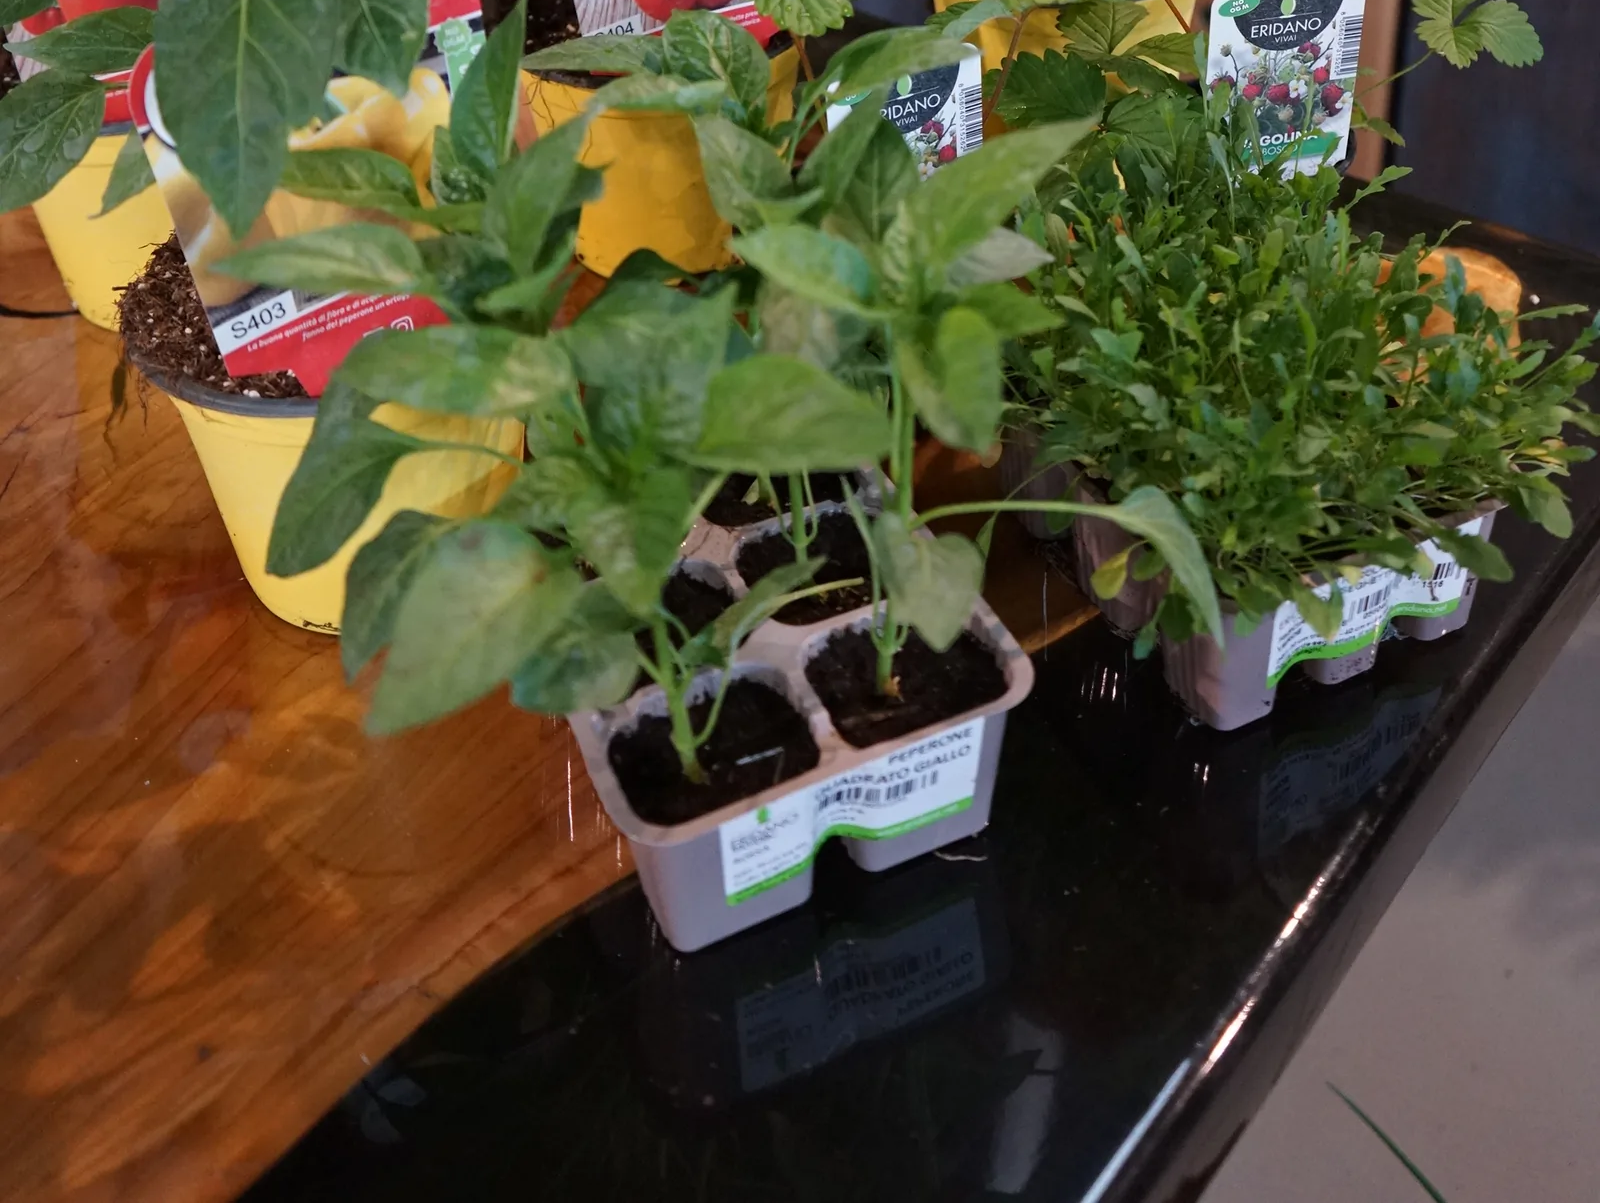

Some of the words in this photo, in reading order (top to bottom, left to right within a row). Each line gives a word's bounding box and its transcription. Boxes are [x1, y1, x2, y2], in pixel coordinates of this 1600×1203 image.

[1229, 3, 1250, 14] OGM
[1232, 0, 1245, 7] NO
[1251, 17, 1322, 39] ERIDANO
[1275, 34, 1297, 43] VIVAI
[879, 93, 941, 121] RIDANO
[896, 115, 918, 127] VIVAI
[231, 301, 287, 340] S403
[338, 305, 374, 327] peperone
[258, 332, 284, 348] buona
[326, 307, 346, 323] fibra
[888, 726, 974, 765] PEPERONE
[913, 744, 971, 773] GIALLO
